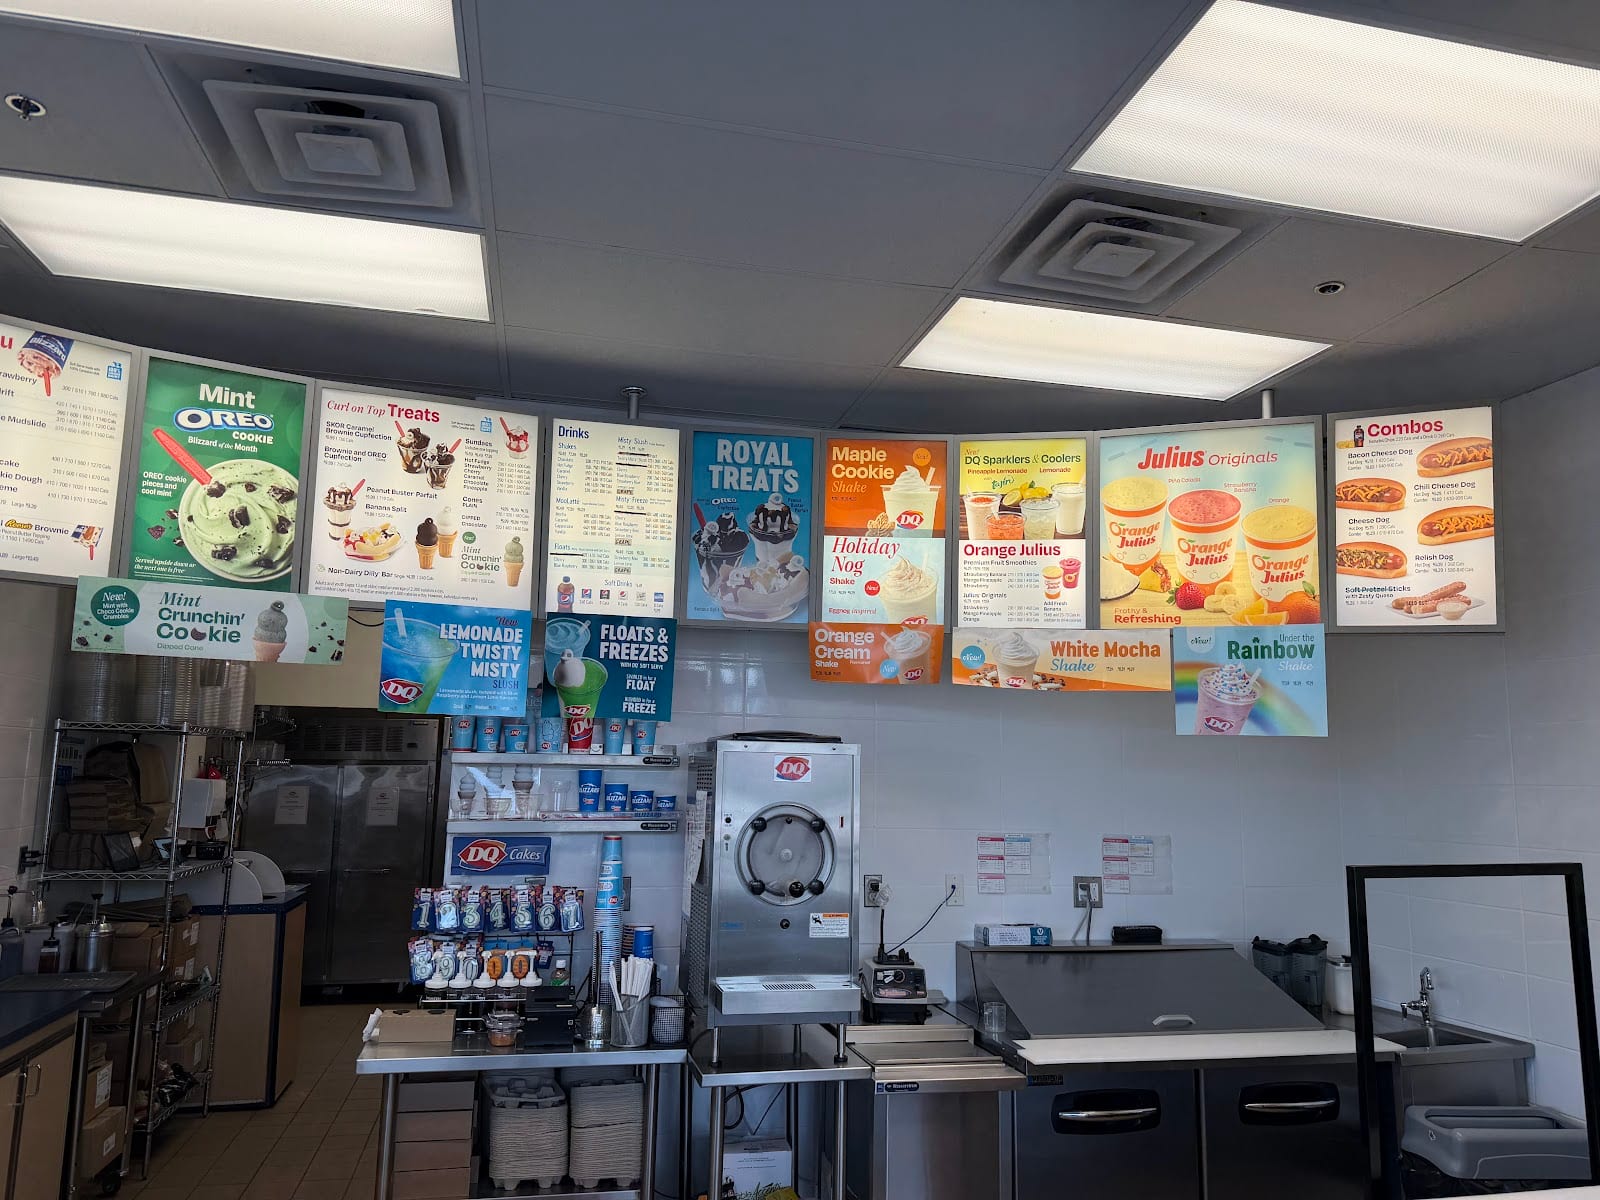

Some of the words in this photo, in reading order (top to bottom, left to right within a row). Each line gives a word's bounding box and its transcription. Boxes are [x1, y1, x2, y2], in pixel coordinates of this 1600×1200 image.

[199, 383, 256, 409] Mint
[326, 399, 349, 412] Curl
[351, 403, 364, 413] on
[367, 404, 386, 418] Top
[387, 403, 440, 423] Treats
[8, 415, 47, 429] Mudslide
[176, 407, 274, 431] OREO
[326, 420, 345, 429] SKOR
[346, 423, 375, 432] Caramel
[558, 425, 590, 439] Drinks
[1367, 419, 1444, 438] Combos
[232, 430, 273, 445] COOKIE
[325, 427, 354, 437] Brownie
[355, 430, 392, 441] Cupfection
[187, 436, 218, 448] Blizzard
[225, 442, 234, 450] the
[234, 442, 258, 453] Month
[324, 452, 362, 462] Cupfection
[717, 438, 793, 466] ROYAL
[831, 446, 887, 464] Maple
[1137, 445, 1205, 470] Julius
[1207, 452, 1279, 468] Originals
[1348, 451, 1370, 459] Bacon
[1371, 449, 1398, 457] Cheese
[1398, 447, 1414, 456] Dog
[964, 455, 980, 466] DQ
[982, 454, 1031, 467] Sparklers
[1032, 453, 1040, 464] &
[1041, 453, 1081, 464] Coolers
[143, 471, 163, 480] OREO
[165, 474, 187, 484] cookie
[831, 464, 895, 480] Cookie
[996, 467, 1028, 475] Lemonade
[15, 472, 43, 485] Dough
[142, 480, 163, 489] pieces
[163, 481, 177, 490] and
[708, 464, 799, 493] TREATS
[141, 487, 156, 495] cool
[156, 488, 172, 497] mint
[831, 480, 867, 493] Shake
[1223, 481, 1257, 490] Strawberry
[1413, 483, 1430, 492] Chili
[1431, 482, 1459, 490] Cheese
[1460, 481, 1476, 489] Dog
[366, 486, 390, 496] Peanut
[391, 488, 415, 497] Buster
[416, 489, 438, 500] Parfait
[462, 495, 482, 505] Cones
[365, 503, 390, 512] Banana
[391, 505, 408, 514] Split
[898, 514, 922, 528] DQ
[1348, 517, 1375, 526] Cheese
[1375, 516, 1390, 524] Dog
[35, 524, 69, 535] Brownie
[1109, 520, 1161, 537] Orange
[554, 542, 571, 551] Floats
[831, 536, 901, 558] Holiday
[1117, 536, 1157, 549] Julius
[1177, 537, 1232, 555] Orange
[461, 545, 481, 555] Mint
[963, 543, 1017, 559] Orange
[1019, 543, 1061, 556] Julius
[460, 553, 502, 563] Crunchin'
[1185, 552, 1228, 567] Julius
[1252, 553, 1309, 572] Orange
[1415, 553, 1437, 561] Relish
[1438, 553, 1454, 561] Dog
[327, 566, 364, 578] Non-Dairy
[381, 569, 393, 578] Bar
[831, 555, 865, 577] Nog
[604, 579, 616, 587] Soft
[616, 579, 633, 588] Drinks
[829, 577, 855, 585] Shake
[1260, 569, 1305, 585] Julius
[102, 591, 126, 602] New!
[159, 591, 203, 608] Mint
[96, 608, 115, 616] Choco
[115, 607, 134, 615] Cookie
[102, 612, 129, 621] Crumbles
[158, 606, 246, 626] Crunchin'
[1114, 607, 1141, 615] Frothy
[1114, 613, 1181, 625] Refreshing
[439, 622, 524, 644] LEMONADE
[600, 623, 655, 642] FLOATS
[656, 627, 669, 643] &
[814, 628, 875, 645] Orange
[1279, 633, 1301, 642] Under
[1302, 633, 1315, 642] the
[156, 642, 183, 653] Dipped
[183, 644, 204, 652] Cone
[1190, 636, 1212, 646] New!
[460, 642, 522, 661] TWISTY
[599, 641, 669, 663] FREEZES
[814, 644, 871, 660] Cream
[1049, 640, 1100, 658] White
[1103, 640, 1161, 658] Mocha
[1227, 638, 1316, 660] Rainbow
[470, 660, 521, 679] MISTY
[815, 659, 839, 668] Shake
[1049, 657, 1097, 672] Shake
[1278, 659, 1313, 671] Shake
[905, 669, 923, 679] DQ
[492, 679, 519, 689] SLUSH
[625, 679, 656, 692] FLOAT
[1008, 678, 1025, 687] DQ
[387, 681, 419, 700] DQ
[569, 706, 588, 715] DQ
[622, 702, 657, 715] FREEZE
[1208, 718, 1232, 731] DQ
[781, 762, 806, 775] DQ
[466, 846, 501, 863] DQ
[509, 848, 542, 861] Cakes
